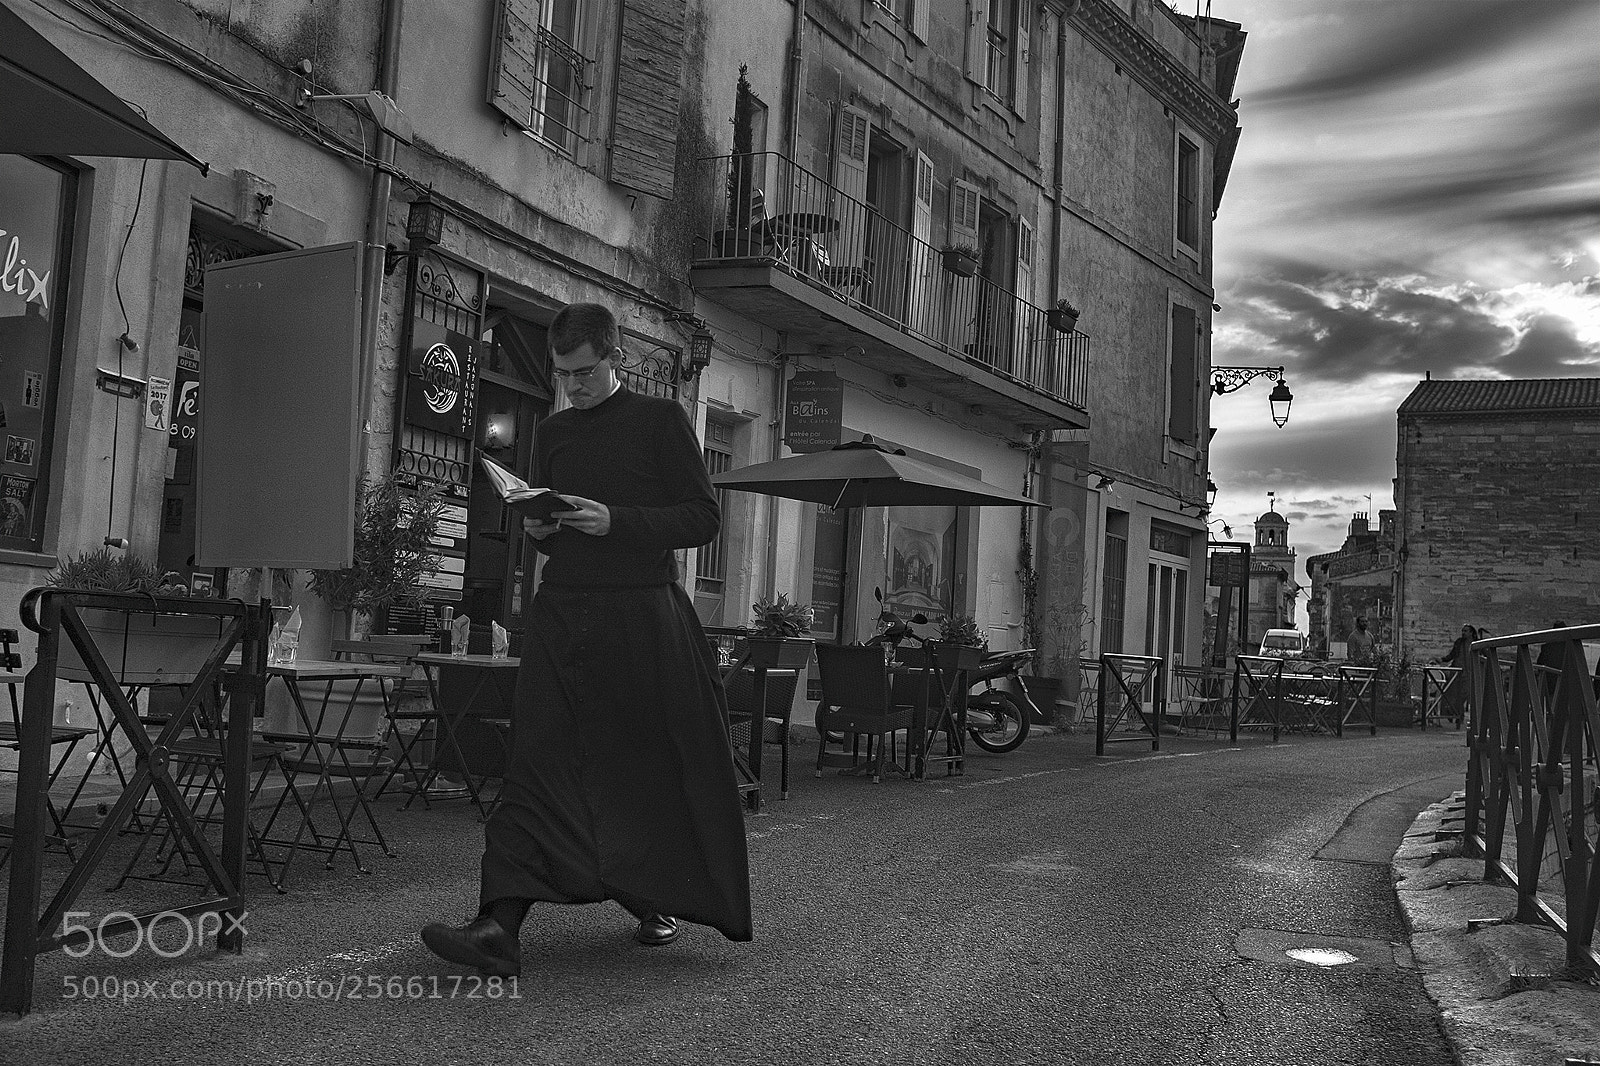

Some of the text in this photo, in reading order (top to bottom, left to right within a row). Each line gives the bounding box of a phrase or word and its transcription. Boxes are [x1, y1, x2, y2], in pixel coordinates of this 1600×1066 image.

[0, 229, 51, 309] lix
[179, 358, 198, 369] OPEN
[419, 363, 461, 393] SAKURA
[462, 345, 473, 433] RESTAURANT
[468, 357, 477, 426] JAPONAIS
[33, 380, 41, 407] veggie
[151, 390, 167, 399] 2017
[176, 380, 200, 418] Fé
[809, 438, 838, 446] Calendal
[5, 487, 27, 498] SALT
